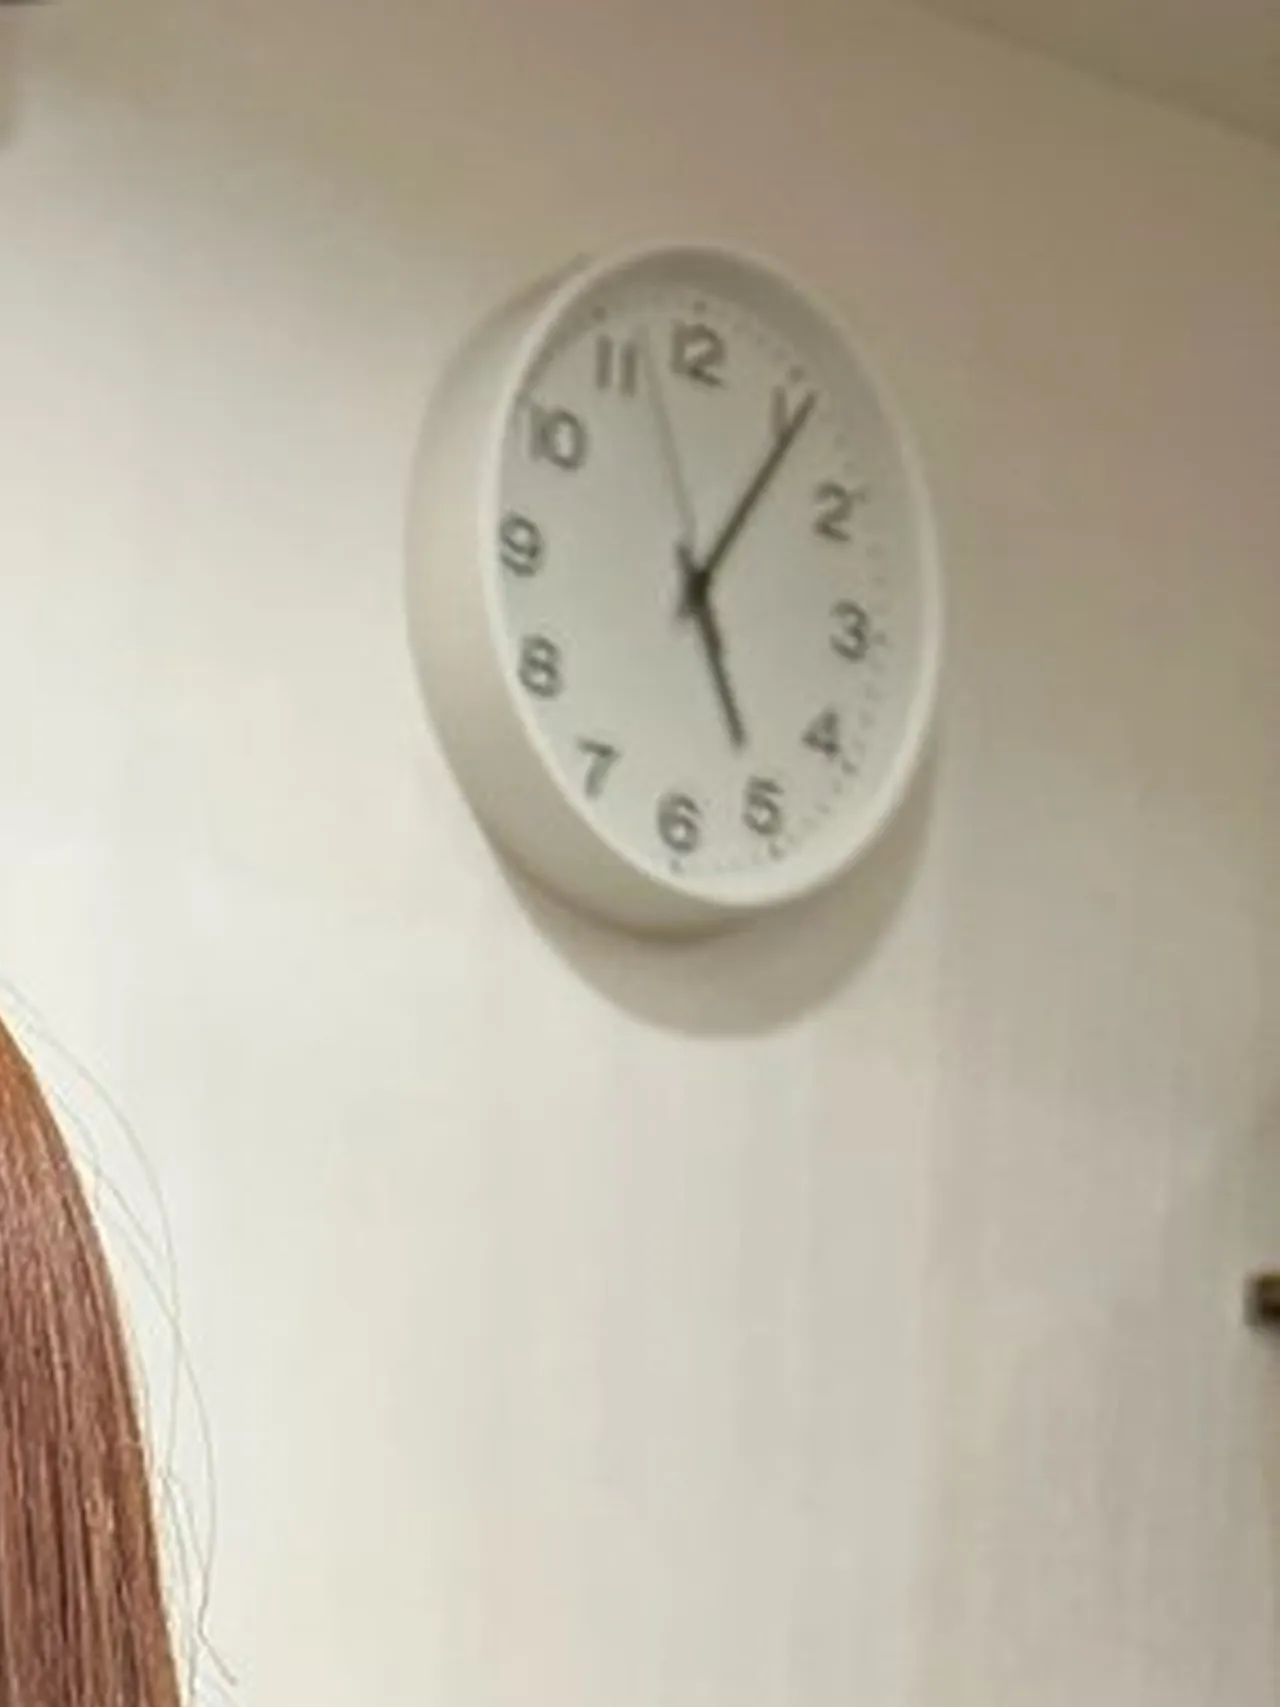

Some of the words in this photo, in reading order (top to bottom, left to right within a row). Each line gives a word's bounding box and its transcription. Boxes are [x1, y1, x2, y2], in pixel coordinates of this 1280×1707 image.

[594, 333, 637, 397] 11
[668, 318, 726, 390] 12
[526, 402, 588, 471] 10
[812, 481, 853, 543] 2
[499, 511, 543, 577] 9
[829, 600, 871, 662] 3
[519, 635, 564, 698] 8
[801, 707, 841, 761] 4
[578, 738, 621, 797] 7
[656, 793, 701, 854] 6
[743, 775, 783, 836] 5
